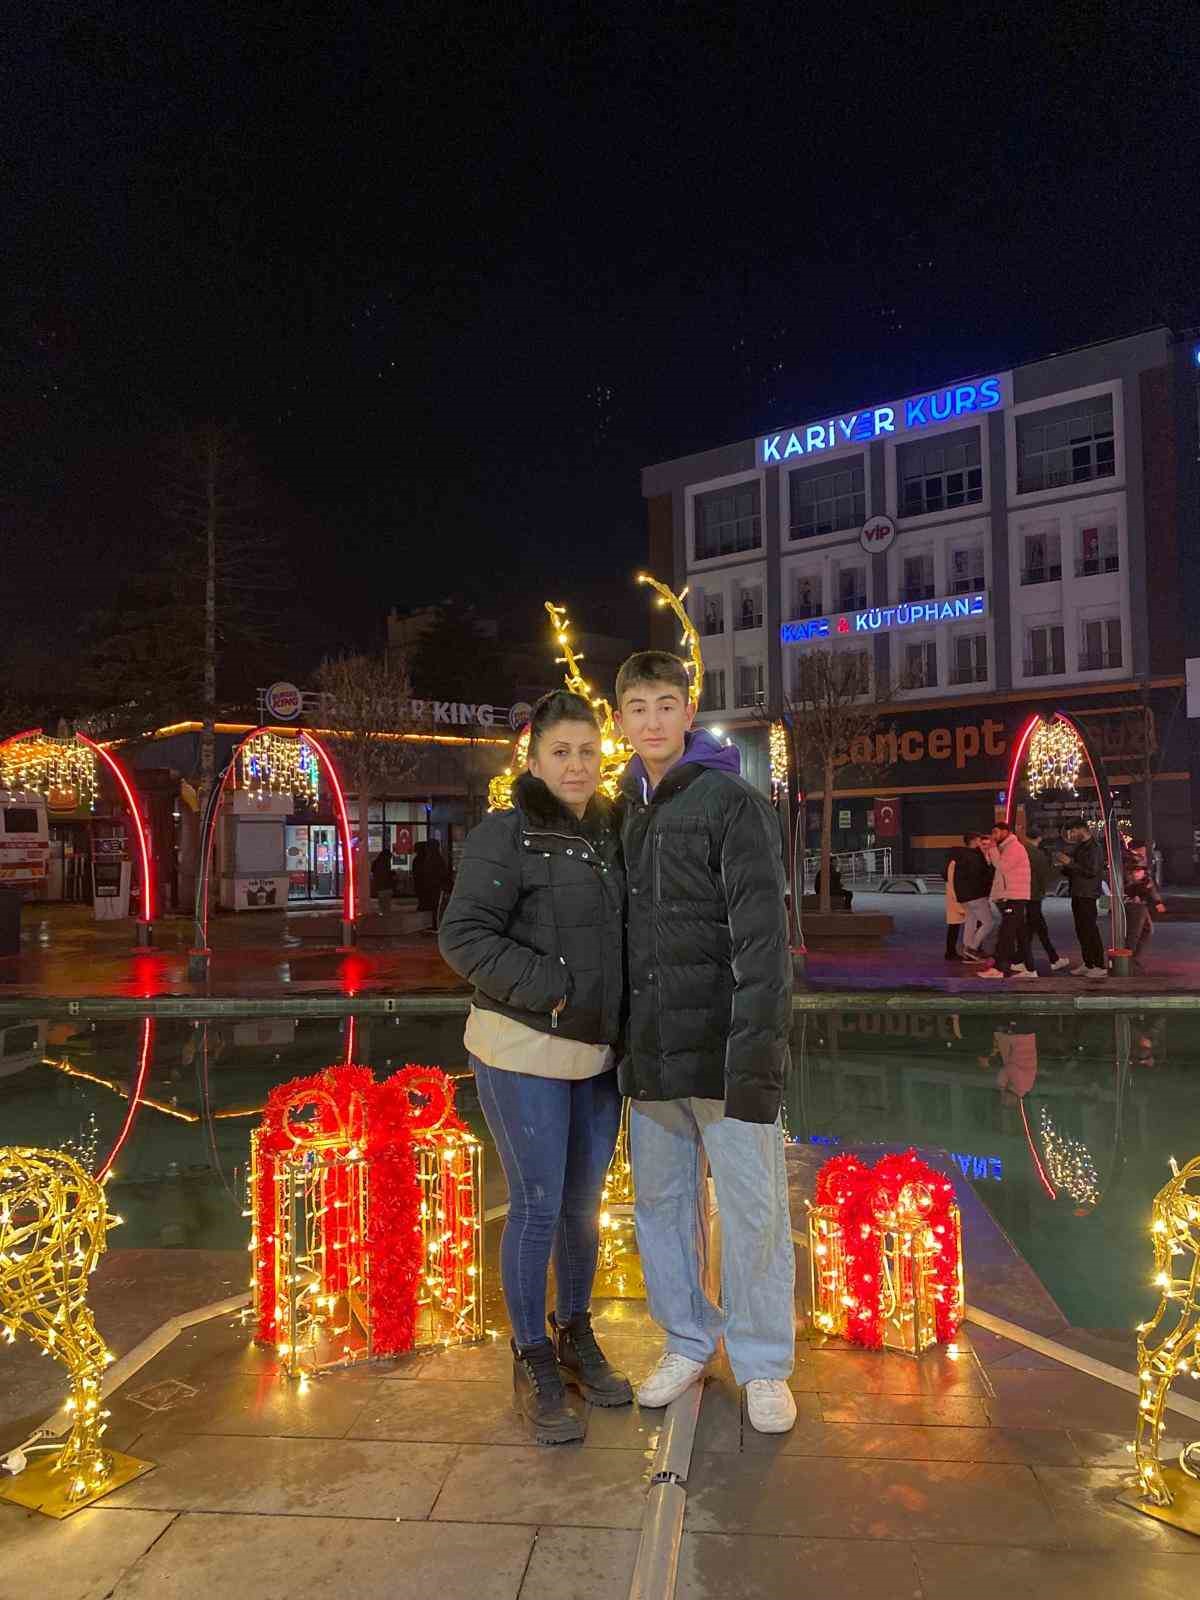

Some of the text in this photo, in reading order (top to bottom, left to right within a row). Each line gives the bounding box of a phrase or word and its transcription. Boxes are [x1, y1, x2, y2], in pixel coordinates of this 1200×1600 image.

[905, 378, 1001, 427] KURS
[781, 617, 830, 643] KAFE
[856, 596, 983, 631] KÜTÜPHANE
[432, 701, 494, 727] KING
